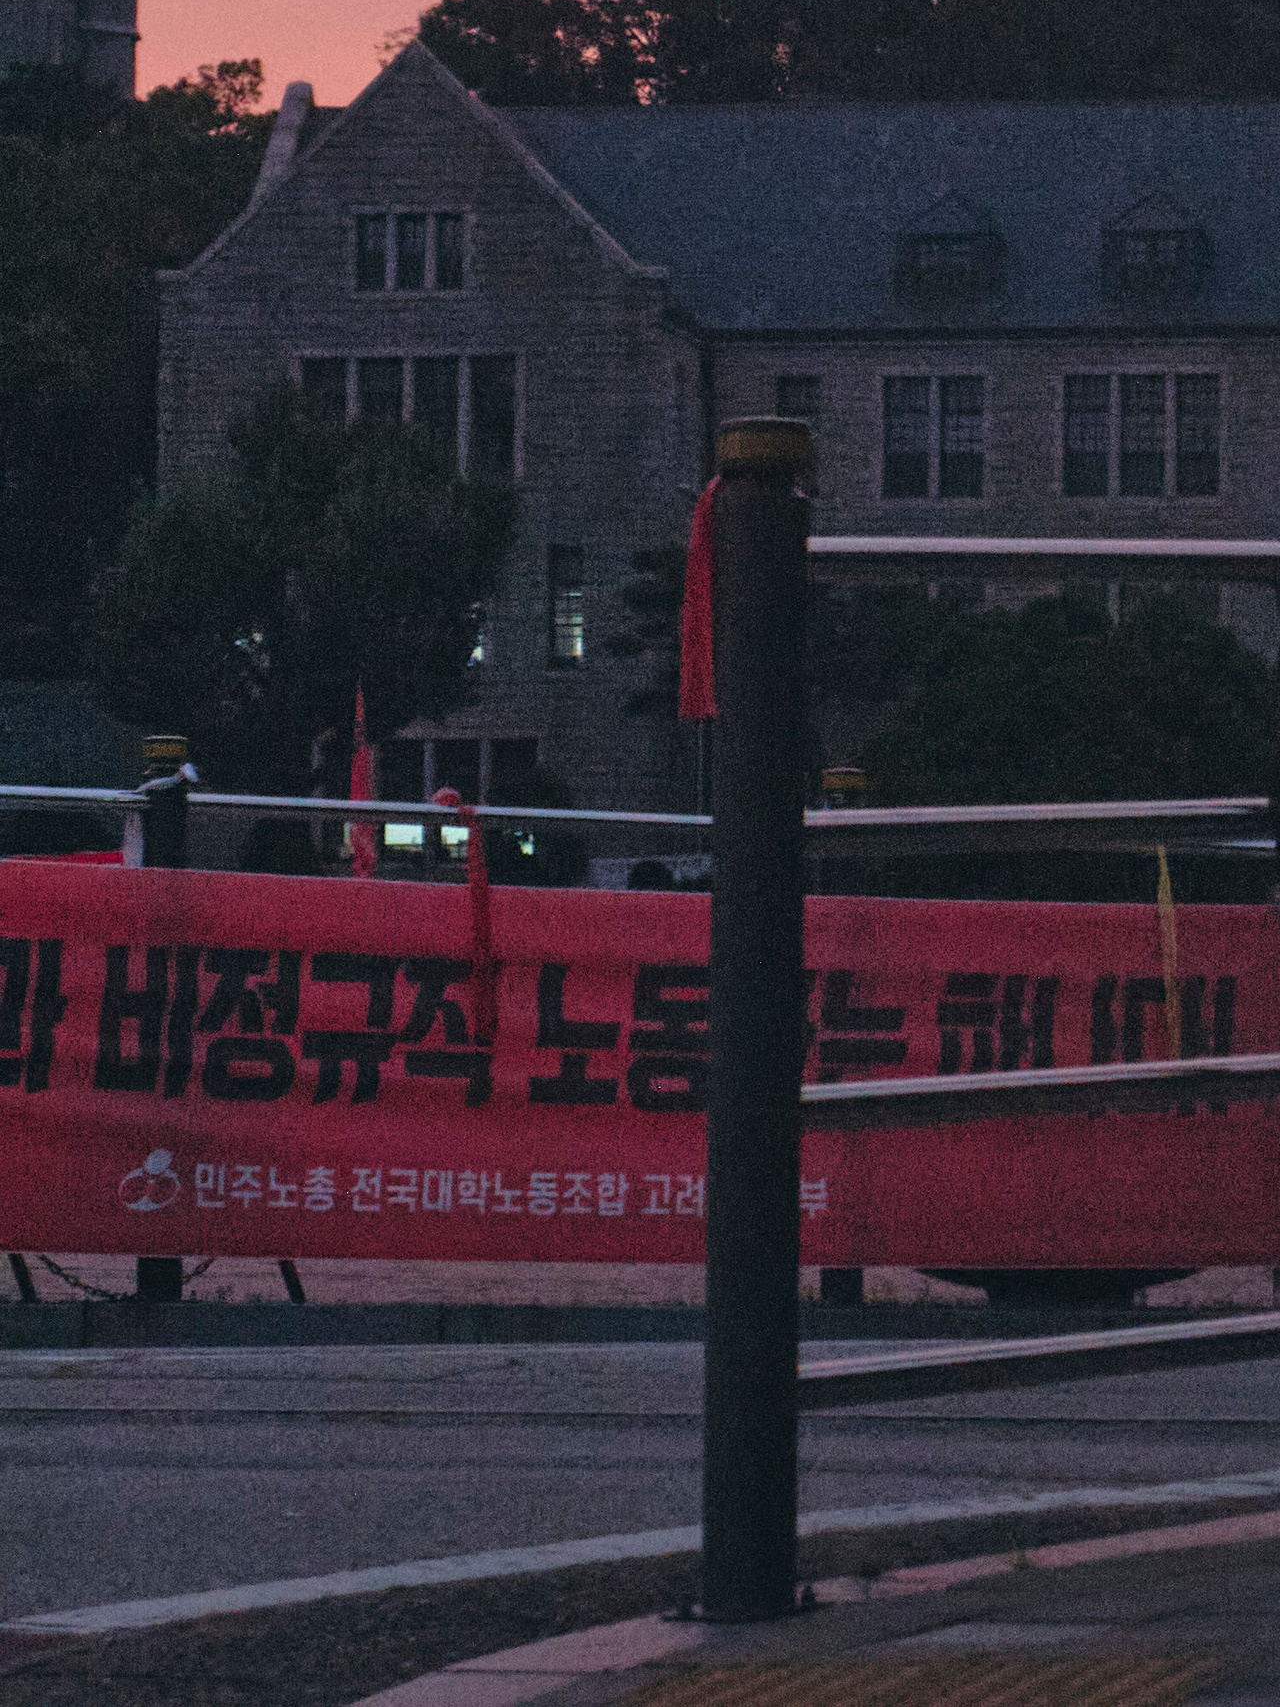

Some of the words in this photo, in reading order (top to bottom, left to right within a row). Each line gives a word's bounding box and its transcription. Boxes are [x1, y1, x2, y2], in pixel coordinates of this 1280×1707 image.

[93, 945, 492, 1106] 비정규직
[528, 963, 908, 1113] 노동는
[195, 1161, 336, 1211] 민주노총
[349, 1165, 629, 1216] 전국대학노동조합
